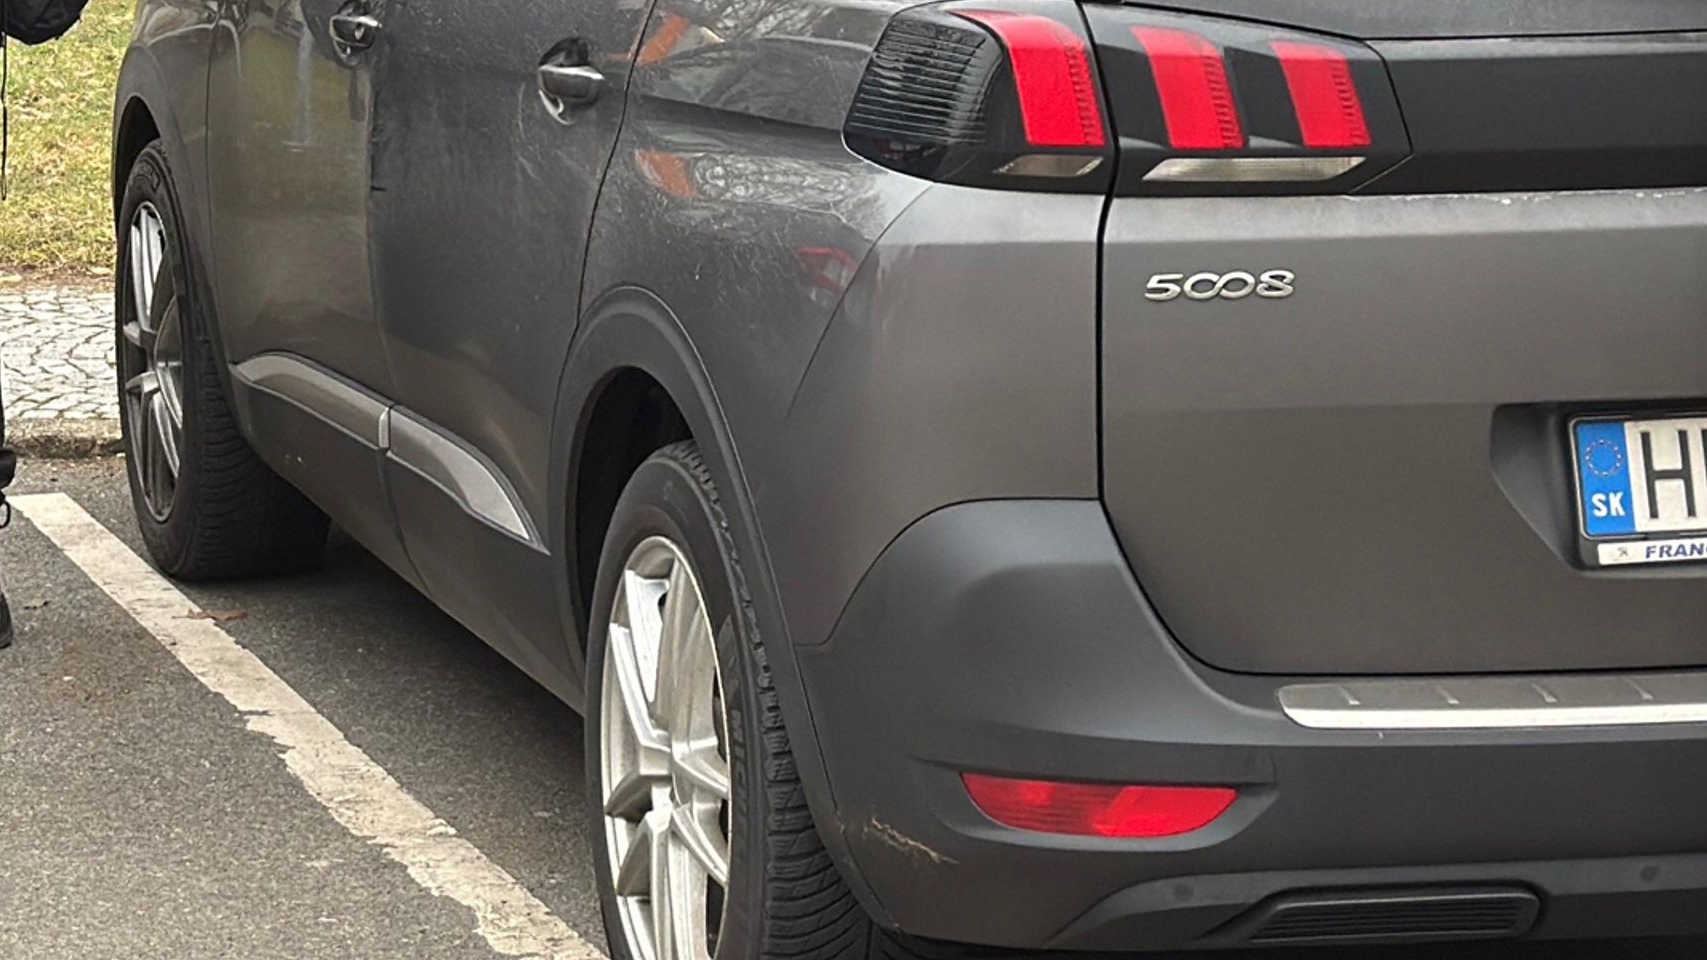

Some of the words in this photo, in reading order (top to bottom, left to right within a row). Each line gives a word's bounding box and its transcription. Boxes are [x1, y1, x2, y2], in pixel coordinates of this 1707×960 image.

[1144, 269, 1295, 301] 5008
[1639, 428, 1707, 519] H
[1591, 491, 1626, 518] SK
[1645, 543, 1707, 559] FRAN
